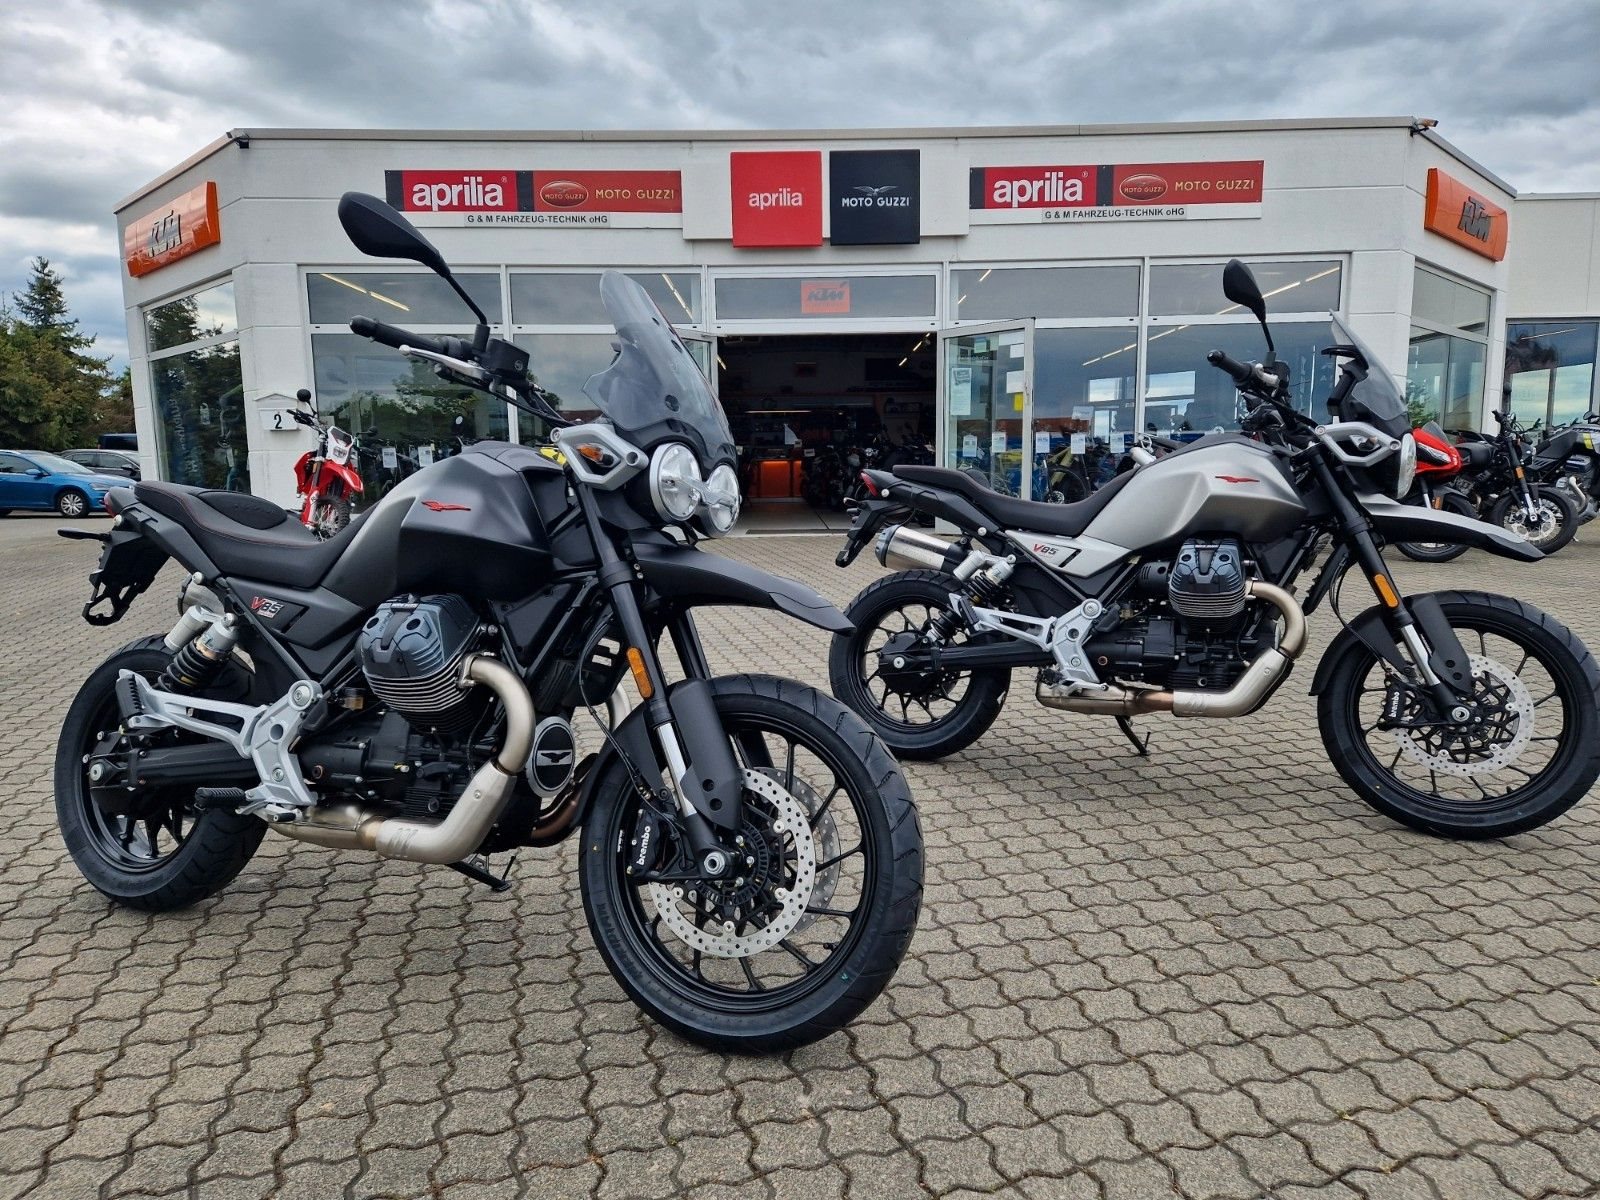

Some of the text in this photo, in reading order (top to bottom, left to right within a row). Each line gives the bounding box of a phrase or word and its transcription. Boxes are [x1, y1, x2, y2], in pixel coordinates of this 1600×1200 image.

[412, 176, 504, 212] aprilia
[595, 189, 674, 200] MOTO GUZZI
[993, 171, 1083, 208] aprilia
[1175, 180, 1255, 192] MOTO GUZZI
[749, 187, 803, 210] aprilia
[842, 197, 910, 207] MOTO GUZZI
[467, 215, 475, 223] G
[477, 215, 484, 223] &
[486, 215, 493, 223] M
[496, 215, 587, 223] FAHRZEUG-TECHNIK
[1045, 211, 1052, 219] G
[1063, 210, 1070, 218] M
[1073, 208, 1163, 218] FAHRZEUG-TECHNIK
[1457, 195, 1492, 243] KTM
[146, 209, 183, 258] KTM
[273, 413, 282, 429] 2
[1033, 543, 1059, 555] V85
[251, 596, 284, 614] V85
[1389, 691, 1400, 718] brembo
[636, 825, 651, 866] brembo
